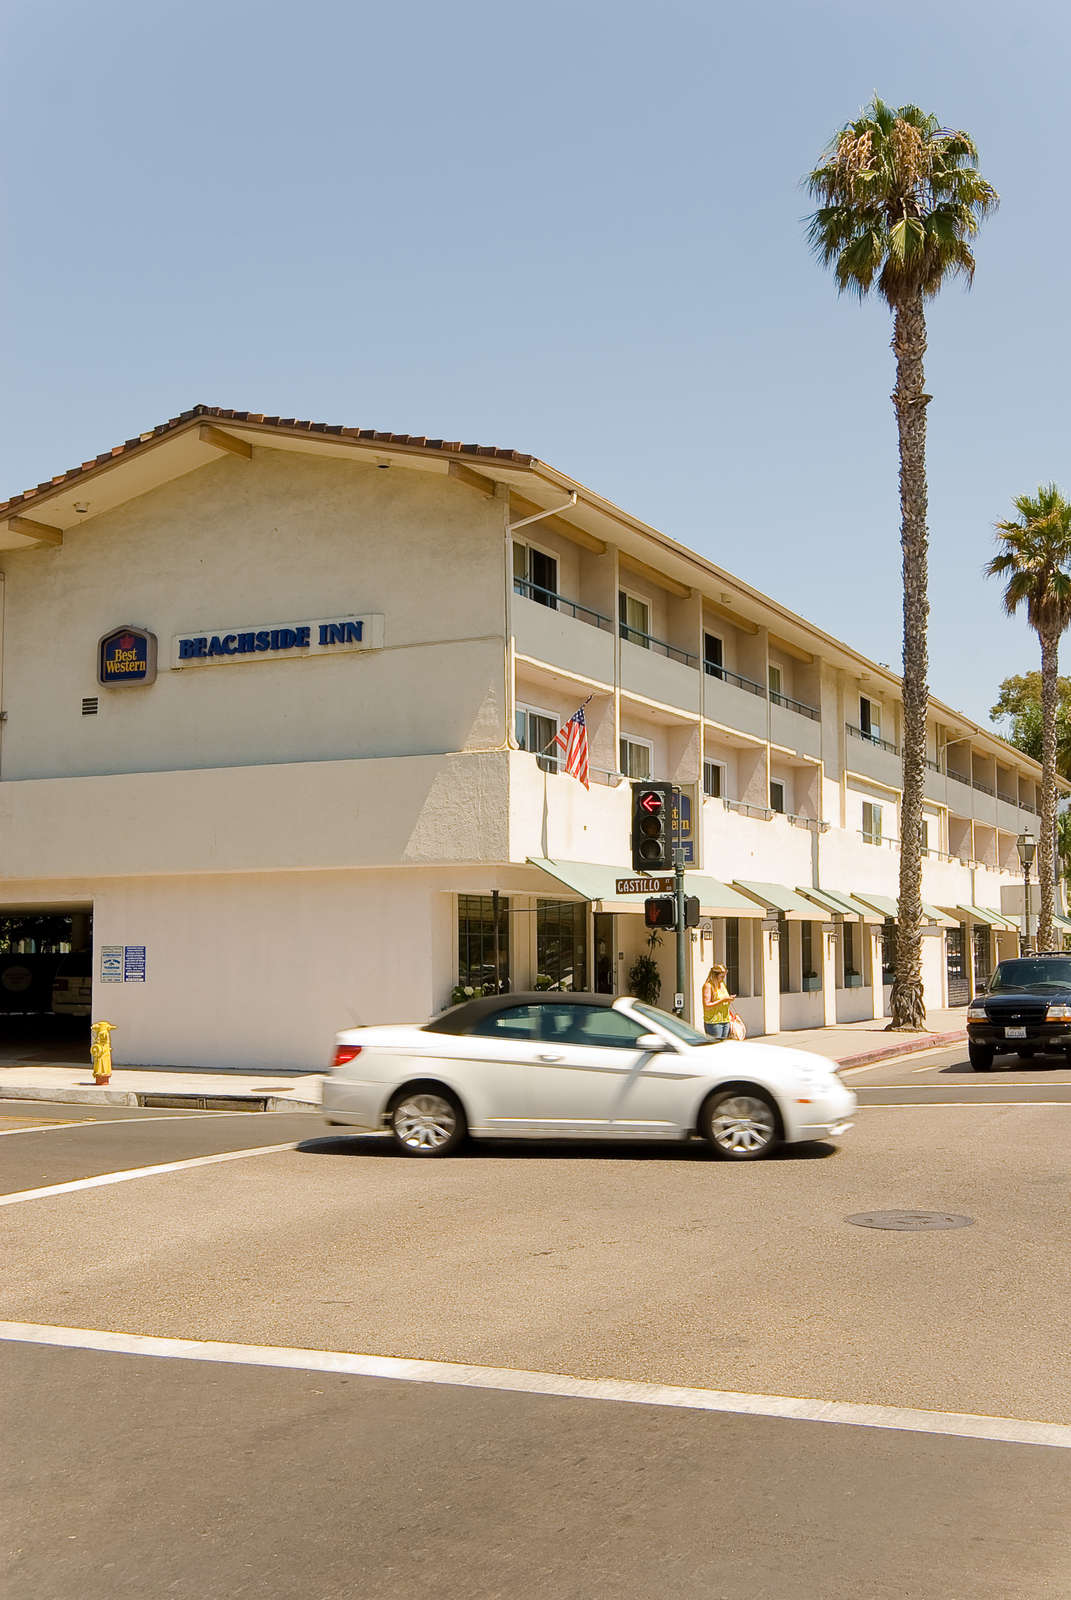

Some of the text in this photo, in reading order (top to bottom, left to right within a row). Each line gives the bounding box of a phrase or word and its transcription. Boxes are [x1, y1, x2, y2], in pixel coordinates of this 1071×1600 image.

[178, 620, 364, 659] BEACHSIDE INN
[115, 648, 137, 661] Best
[106, 660, 146, 673] Western
[617, 879, 660, 892] CASTILLO
